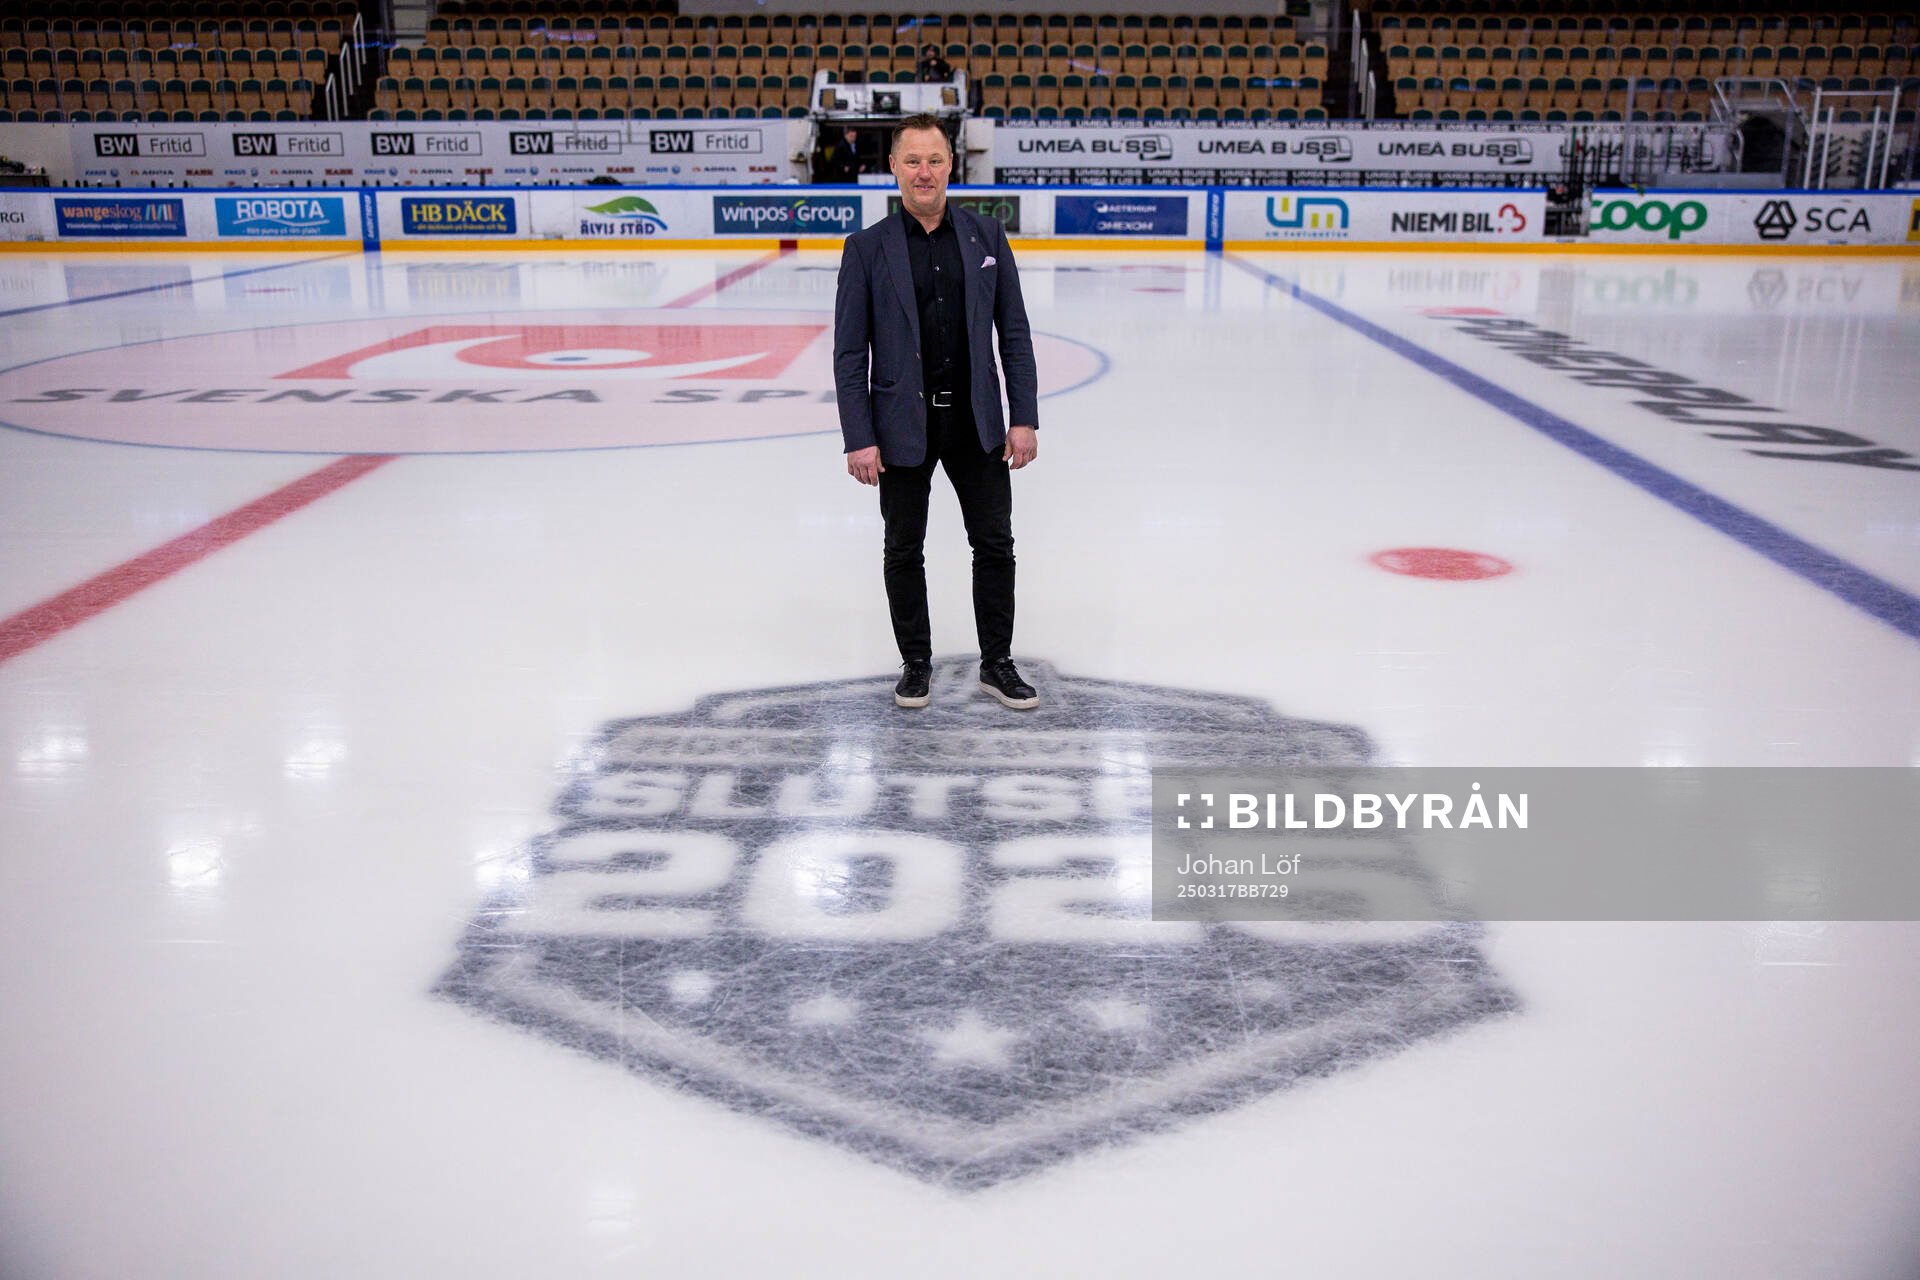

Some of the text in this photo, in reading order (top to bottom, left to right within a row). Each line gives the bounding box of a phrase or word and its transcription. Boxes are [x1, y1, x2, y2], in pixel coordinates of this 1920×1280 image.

[100, 137, 192, 154] BW Fritid
[238, 136, 330, 154] BW Fritid
[376, 135, 469, 153] BW Fritid
[515, 134, 608, 152] BW Fritid
[654, 133, 749, 151] BW Fritid
[1092, 140, 1157, 153] BUSS
[1272, 141, 1337, 154] BUSS
[1452, 143, 1517, 157] BUSS
[62, 203, 142, 221] wangeskog
[236, 200, 325, 219] ROBOTA
[411, 201, 507, 222] HB DÄCK
[620, 219, 656, 235] STÄD
[1392, 213, 1494, 233] NIEMI BIL
[1804, 207, 1871, 233] SCA
[12, 388, 838, 403] SVENSKA SP
